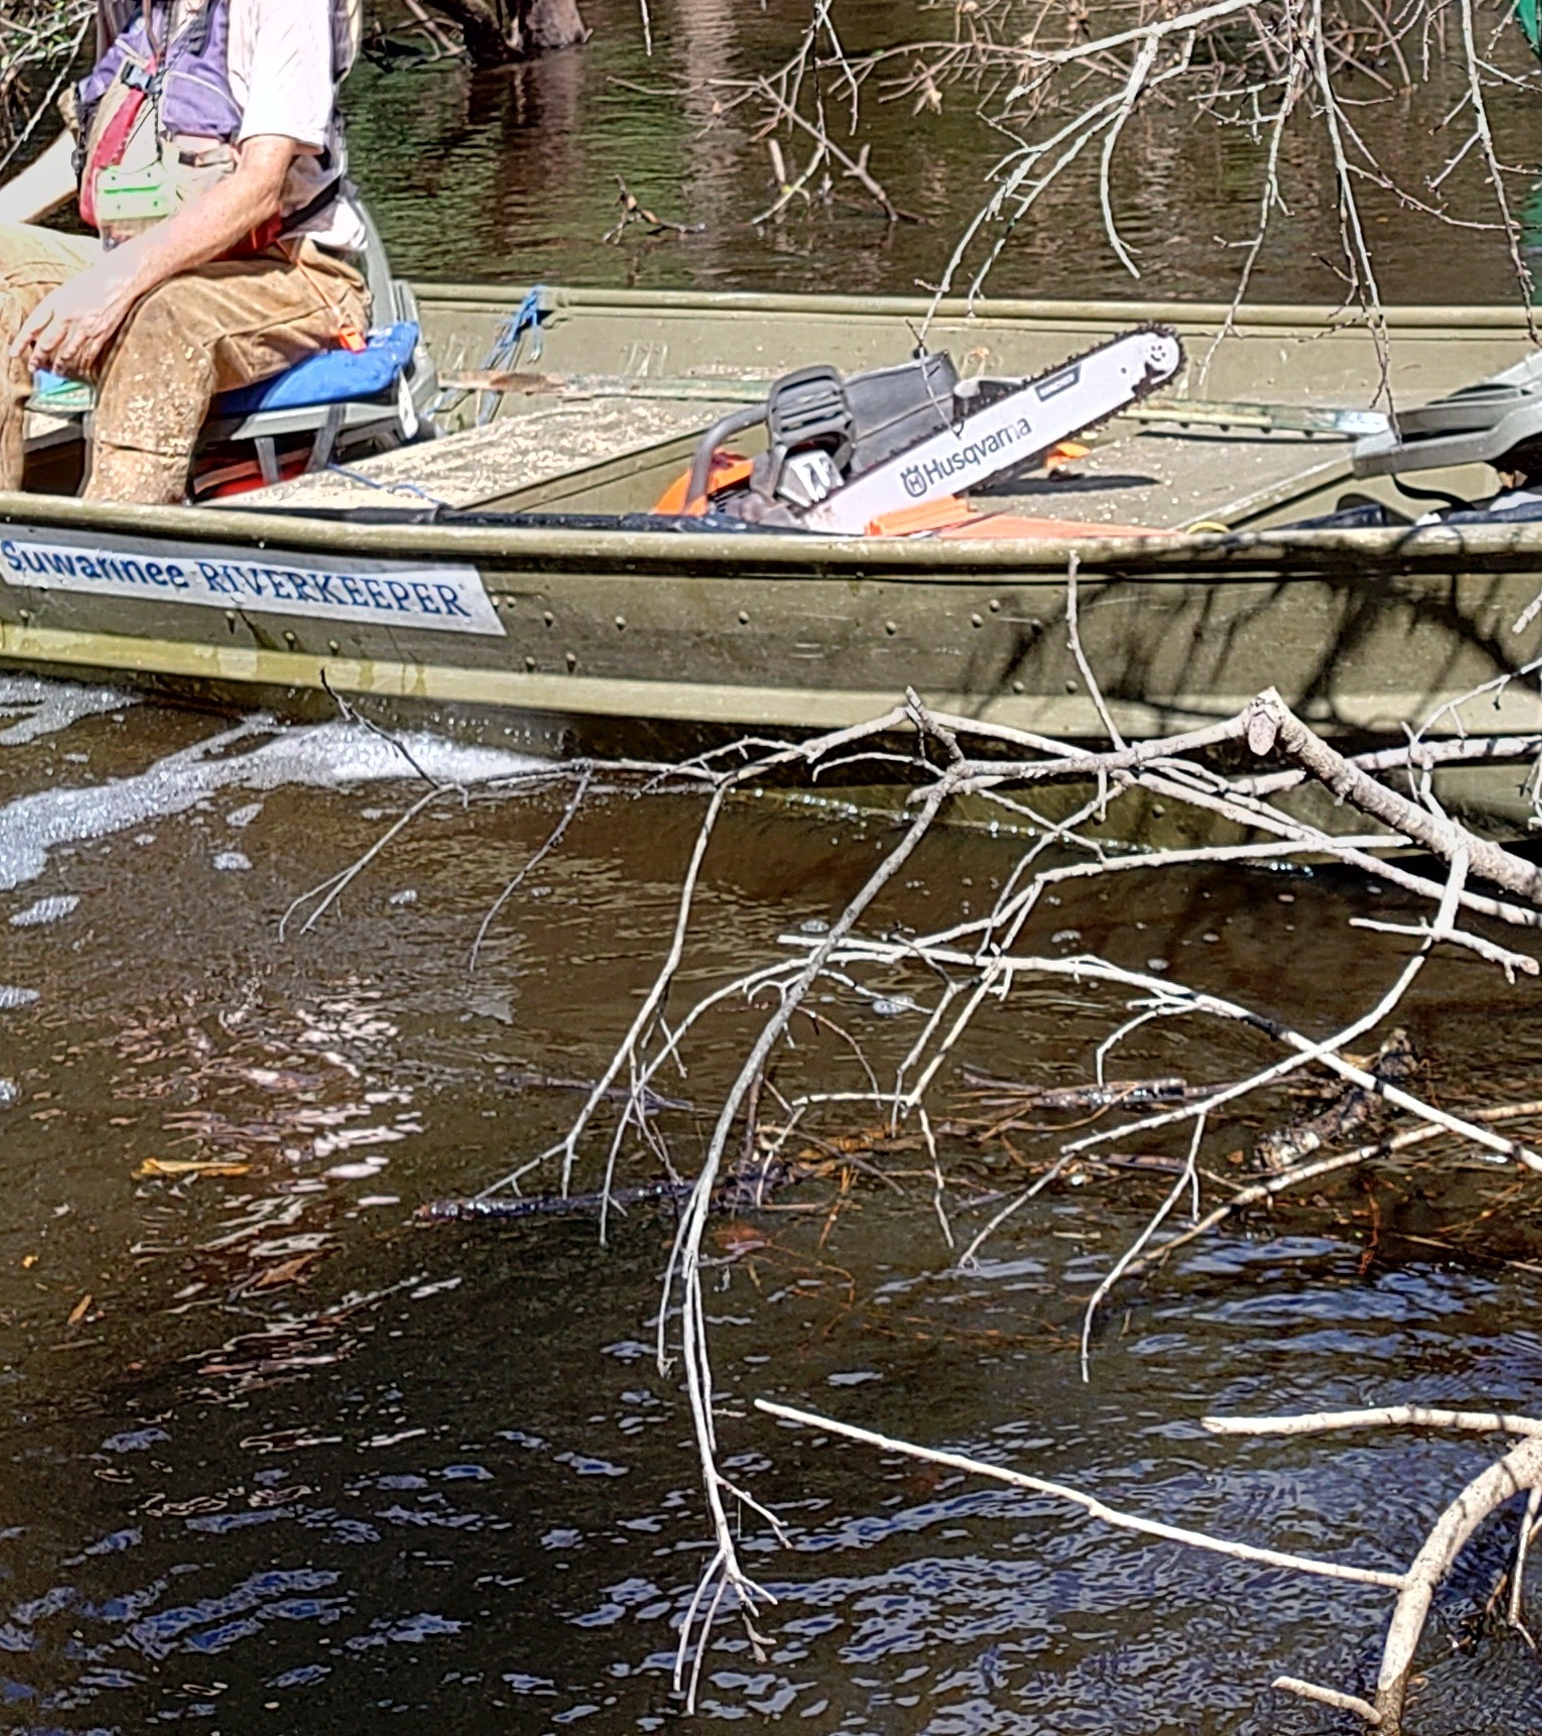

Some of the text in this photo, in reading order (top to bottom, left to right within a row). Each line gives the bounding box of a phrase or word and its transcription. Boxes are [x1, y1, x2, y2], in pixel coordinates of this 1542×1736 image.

[922, 417, 1033, 486] Husqvarna
[0, 539, 472, 618] Suwannee RIVERKEEPER
